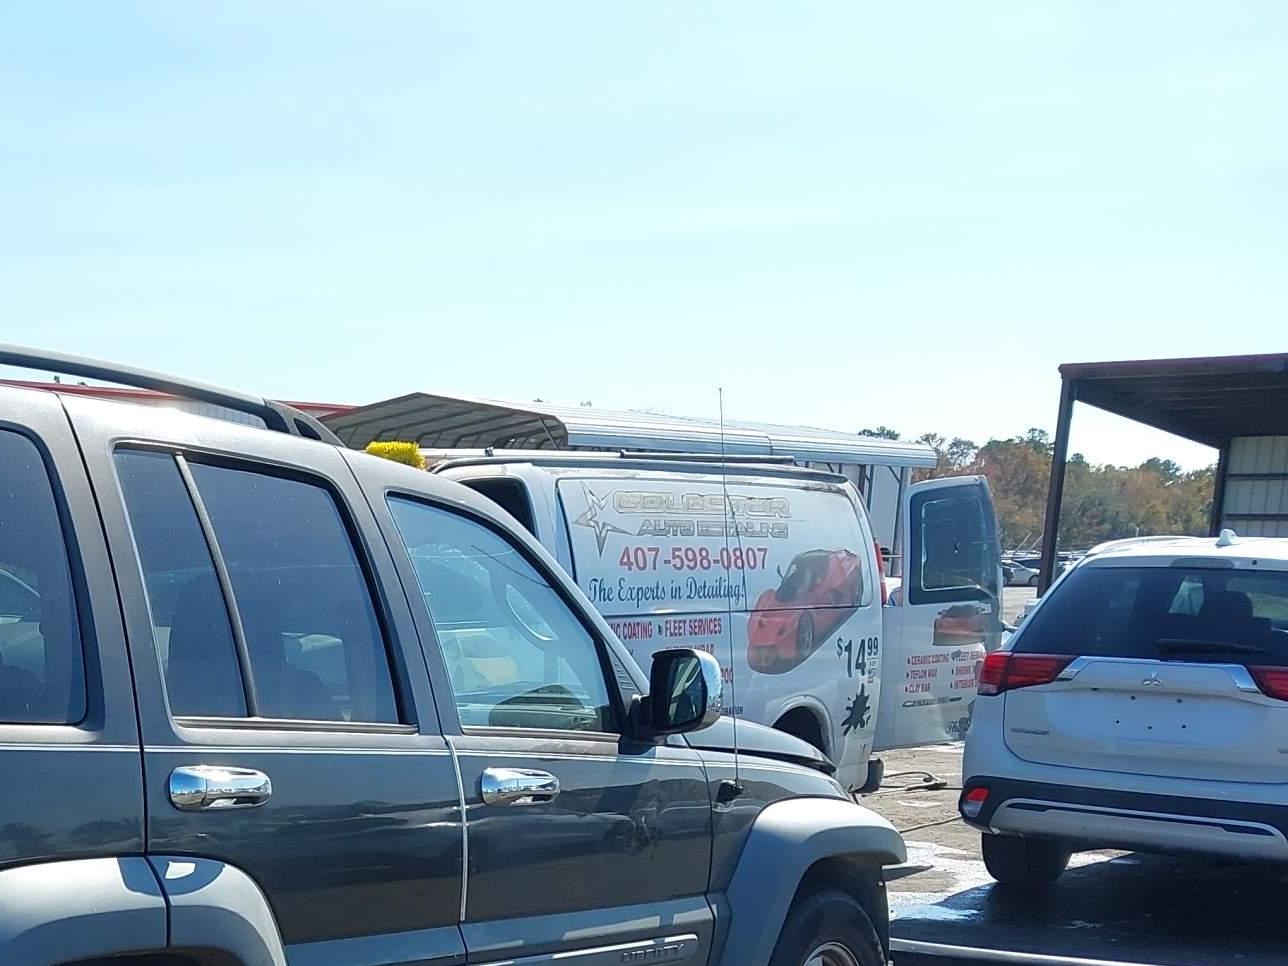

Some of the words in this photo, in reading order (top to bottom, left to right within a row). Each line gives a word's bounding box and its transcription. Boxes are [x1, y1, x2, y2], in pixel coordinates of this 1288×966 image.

[637, 519, 695, 537] AUTO
[619, 547, 768, 571] 407-598-0807
[588, 577, 614, 602] The
[618, 577, 665, 608] Experts
[671, 580, 681, 600] in
[686, 577, 745, 606] Detailing!
[623, 622, 652, 639] COATING
[665, 619, 687, 637] FLEET
[689, 618, 722, 636] SERVICES
